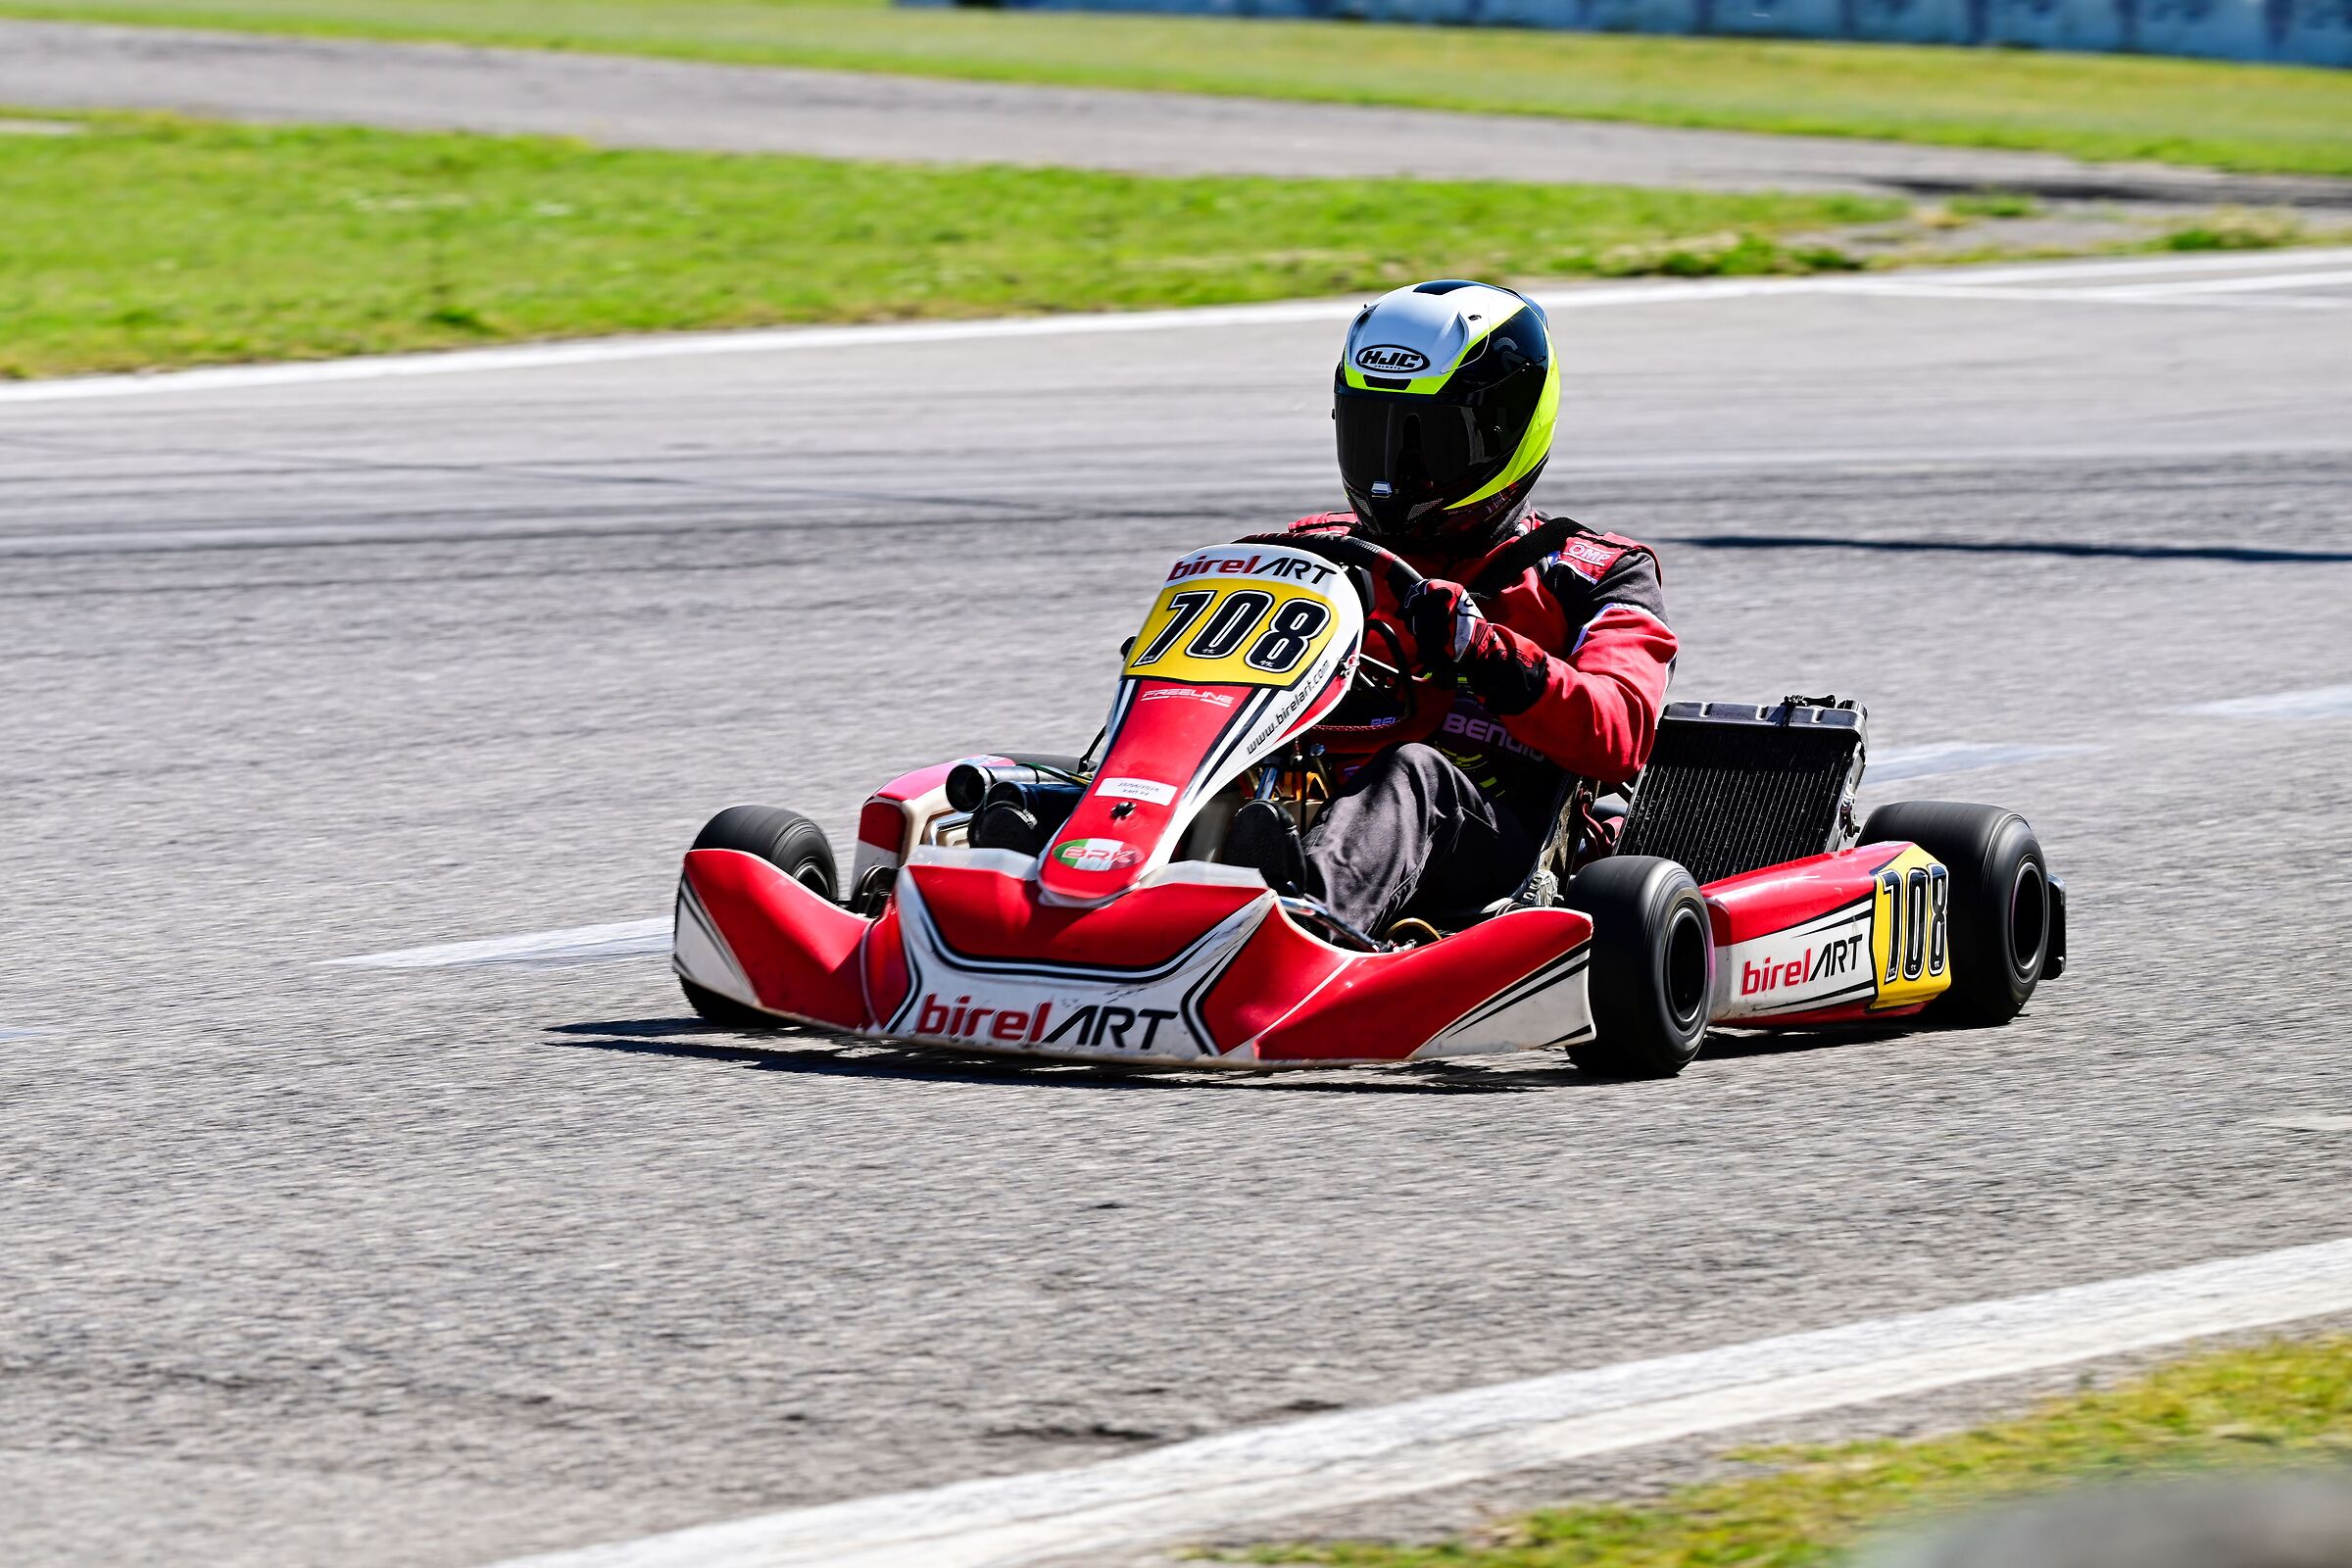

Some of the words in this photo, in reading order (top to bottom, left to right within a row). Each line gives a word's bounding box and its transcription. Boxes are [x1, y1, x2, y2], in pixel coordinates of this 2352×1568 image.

[1360, 350, 1421, 368] HJC
[1568, 544, 1611, 563] OMP
[1143, 688, 1235, 705] FREELINE
[1247, 660, 1330, 755] www.birelart.com
[1878, 863, 1949, 985] 108
